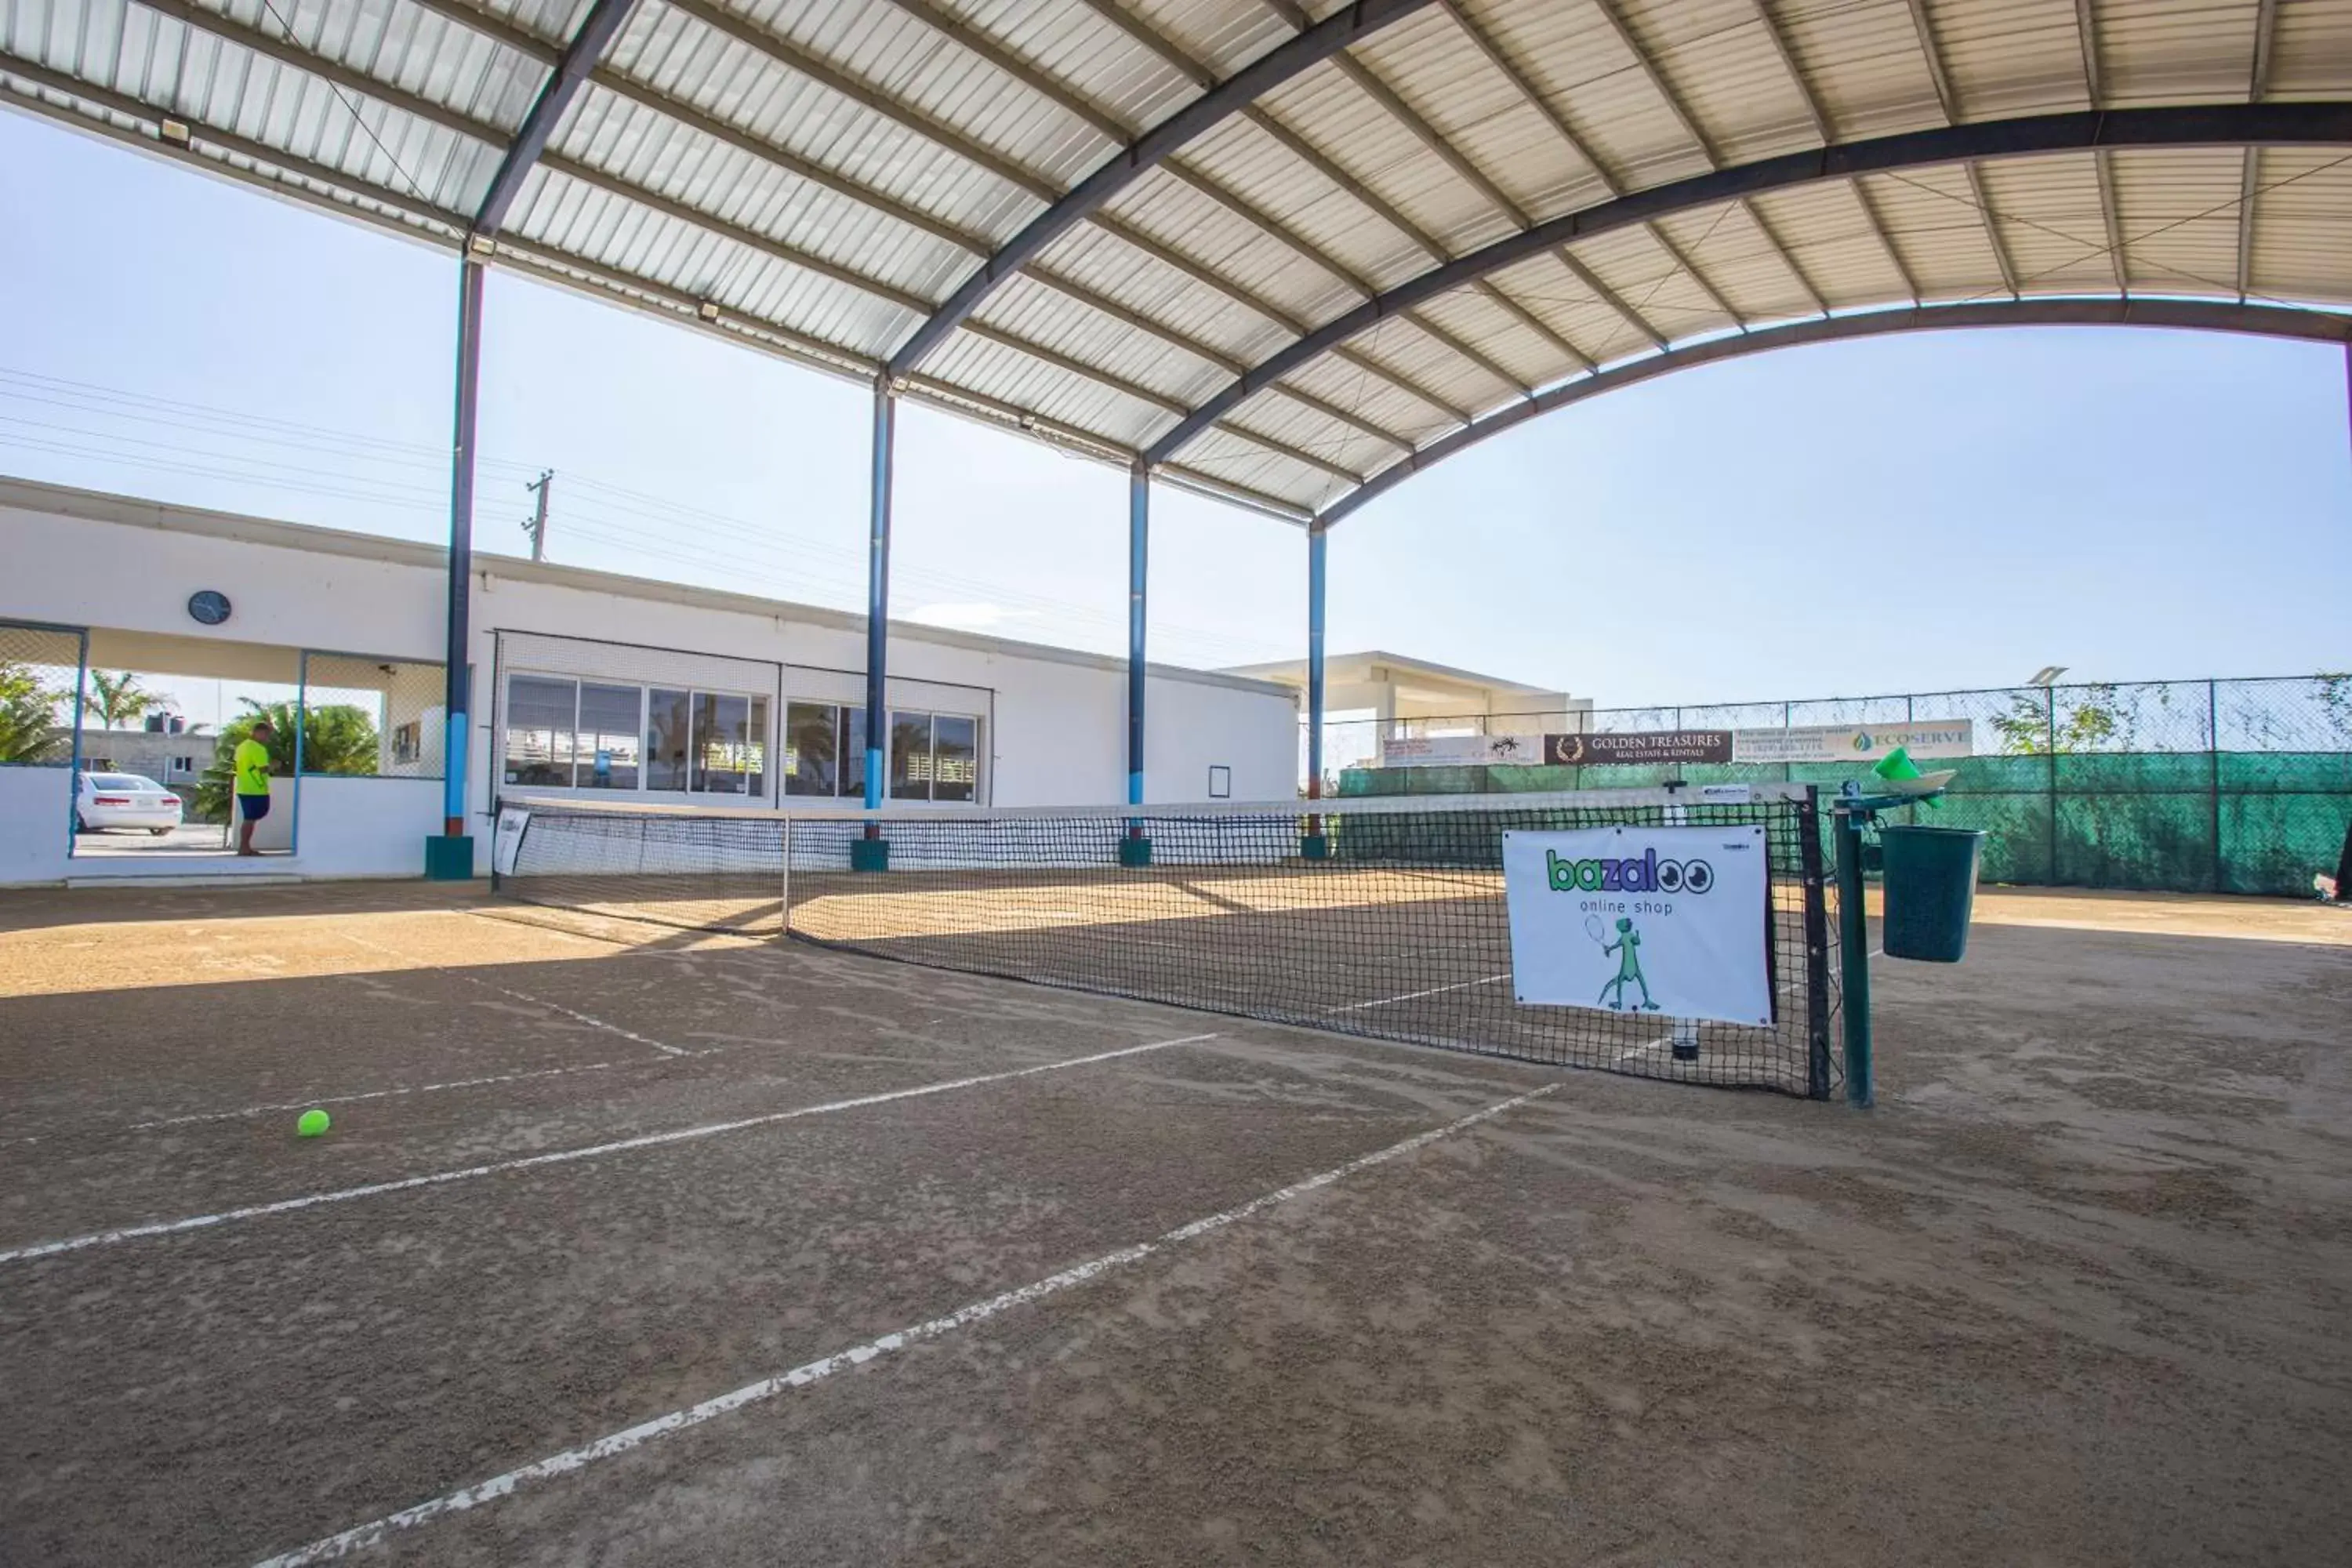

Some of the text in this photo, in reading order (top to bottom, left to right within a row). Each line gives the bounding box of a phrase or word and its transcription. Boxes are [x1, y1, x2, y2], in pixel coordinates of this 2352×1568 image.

[1592, 737, 1646, 750] GOLDEN
[1650, 735, 1721, 748] TREASURES
[1875, 731, 1965, 746] ECOSERVE
[1635, 750, 1661, 758] ESTATE
[1671, 749, 1704, 757] RENTALS
[1546, 848, 1715, 895] bazaloo
[1580, 900, 1672, 916] online shop
